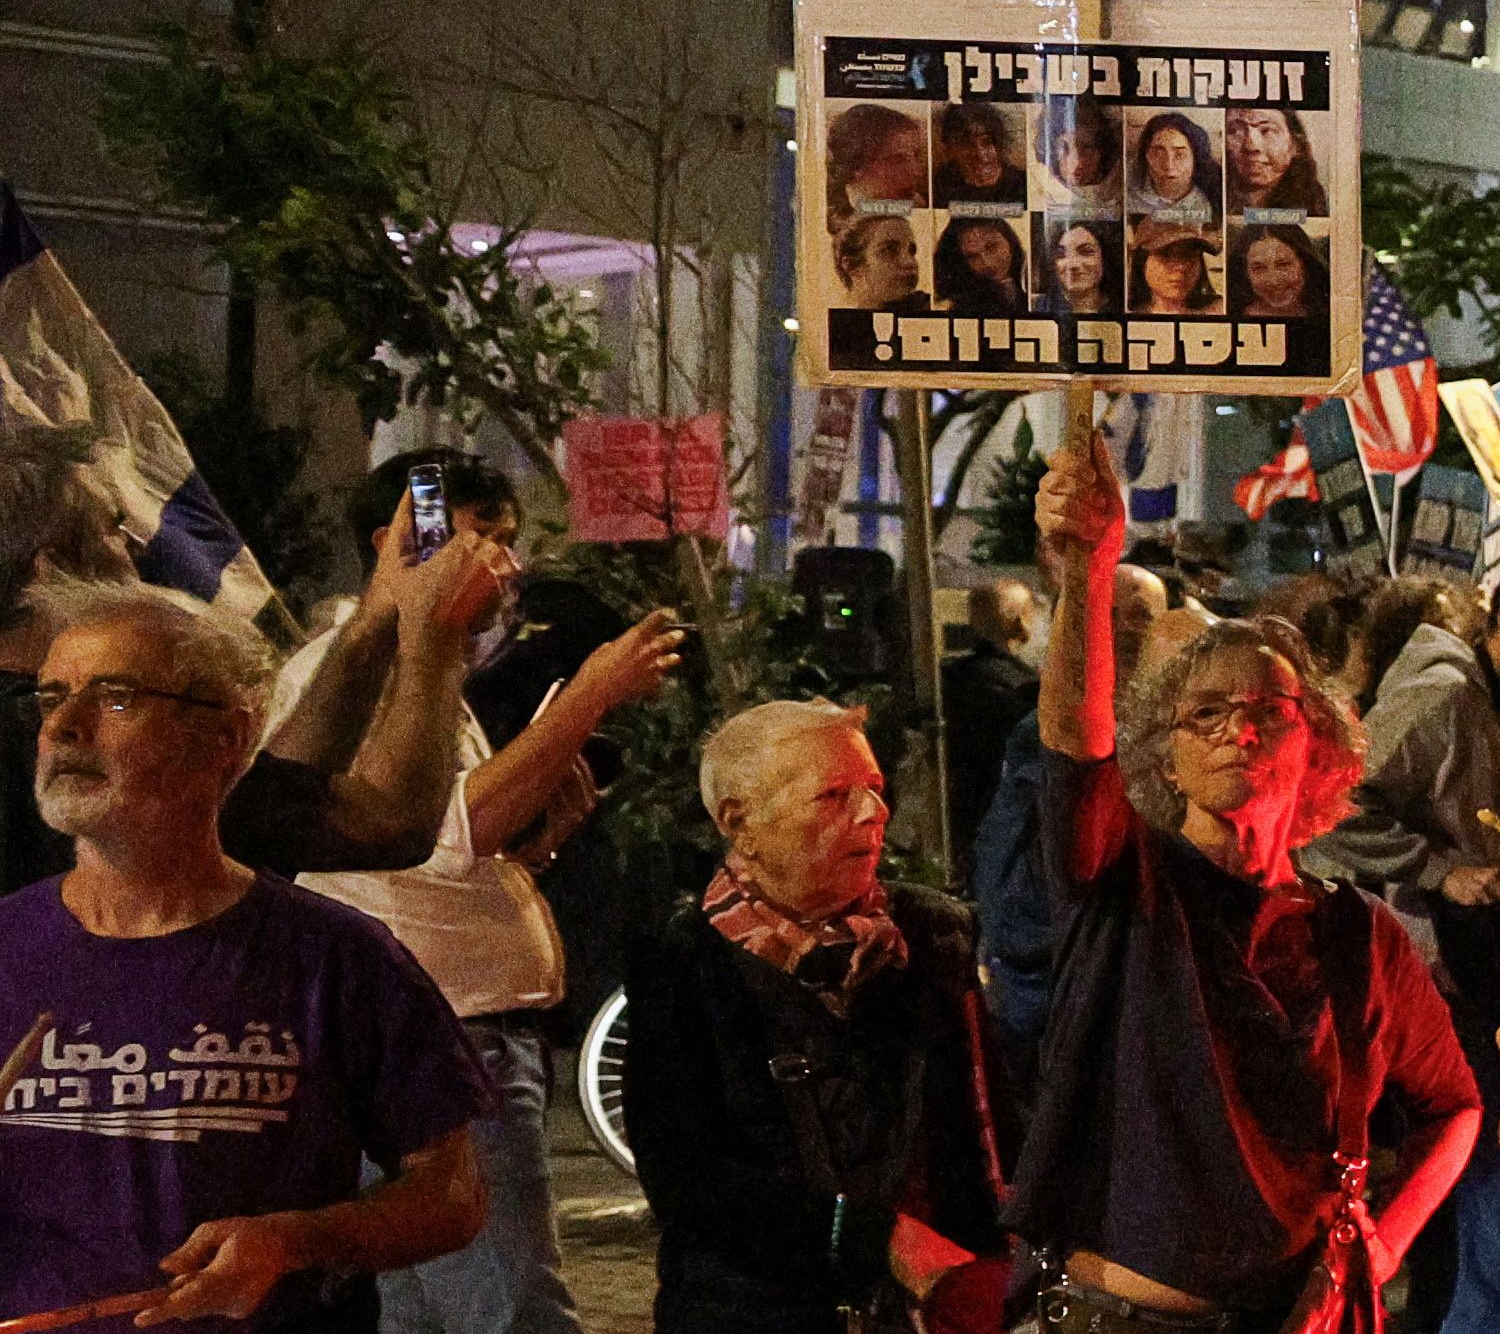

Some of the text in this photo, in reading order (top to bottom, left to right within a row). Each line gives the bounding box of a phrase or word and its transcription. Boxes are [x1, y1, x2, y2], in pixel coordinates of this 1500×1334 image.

[943, 46, 1306, 104] זועקות בשבילן
[872, 312, 1288, 370] עסקה היום!
[4, 1068, 299, 1111] עומדים ביח
